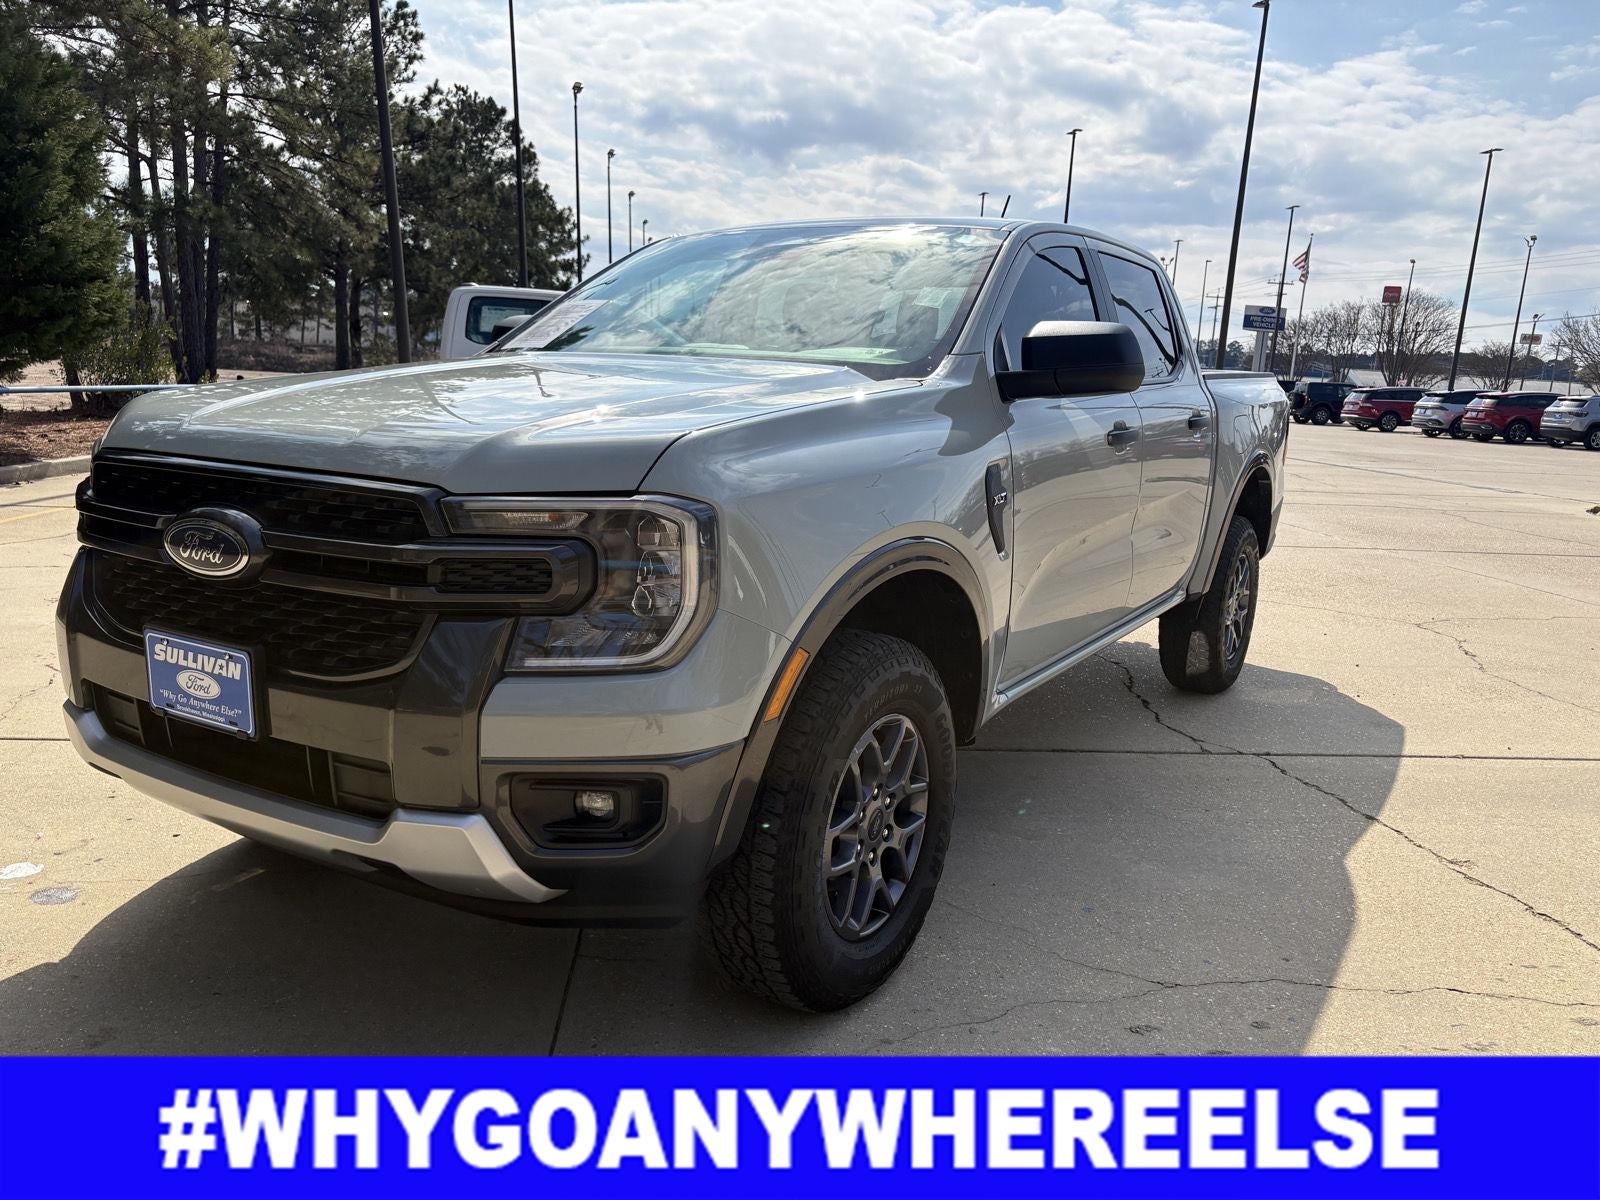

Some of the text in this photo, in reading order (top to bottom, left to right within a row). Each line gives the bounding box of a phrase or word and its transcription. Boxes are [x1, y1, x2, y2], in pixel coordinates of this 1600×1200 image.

[993, 491, 1007, 506] XLT
[179, 530, 225, 564] Ford
[153, 642, 242, 681] SULLIVAN
[185, 674, 211, 695] Ford
[177, 693, 188, 704] Go
[188, 697, 220, 712] Anywhere
